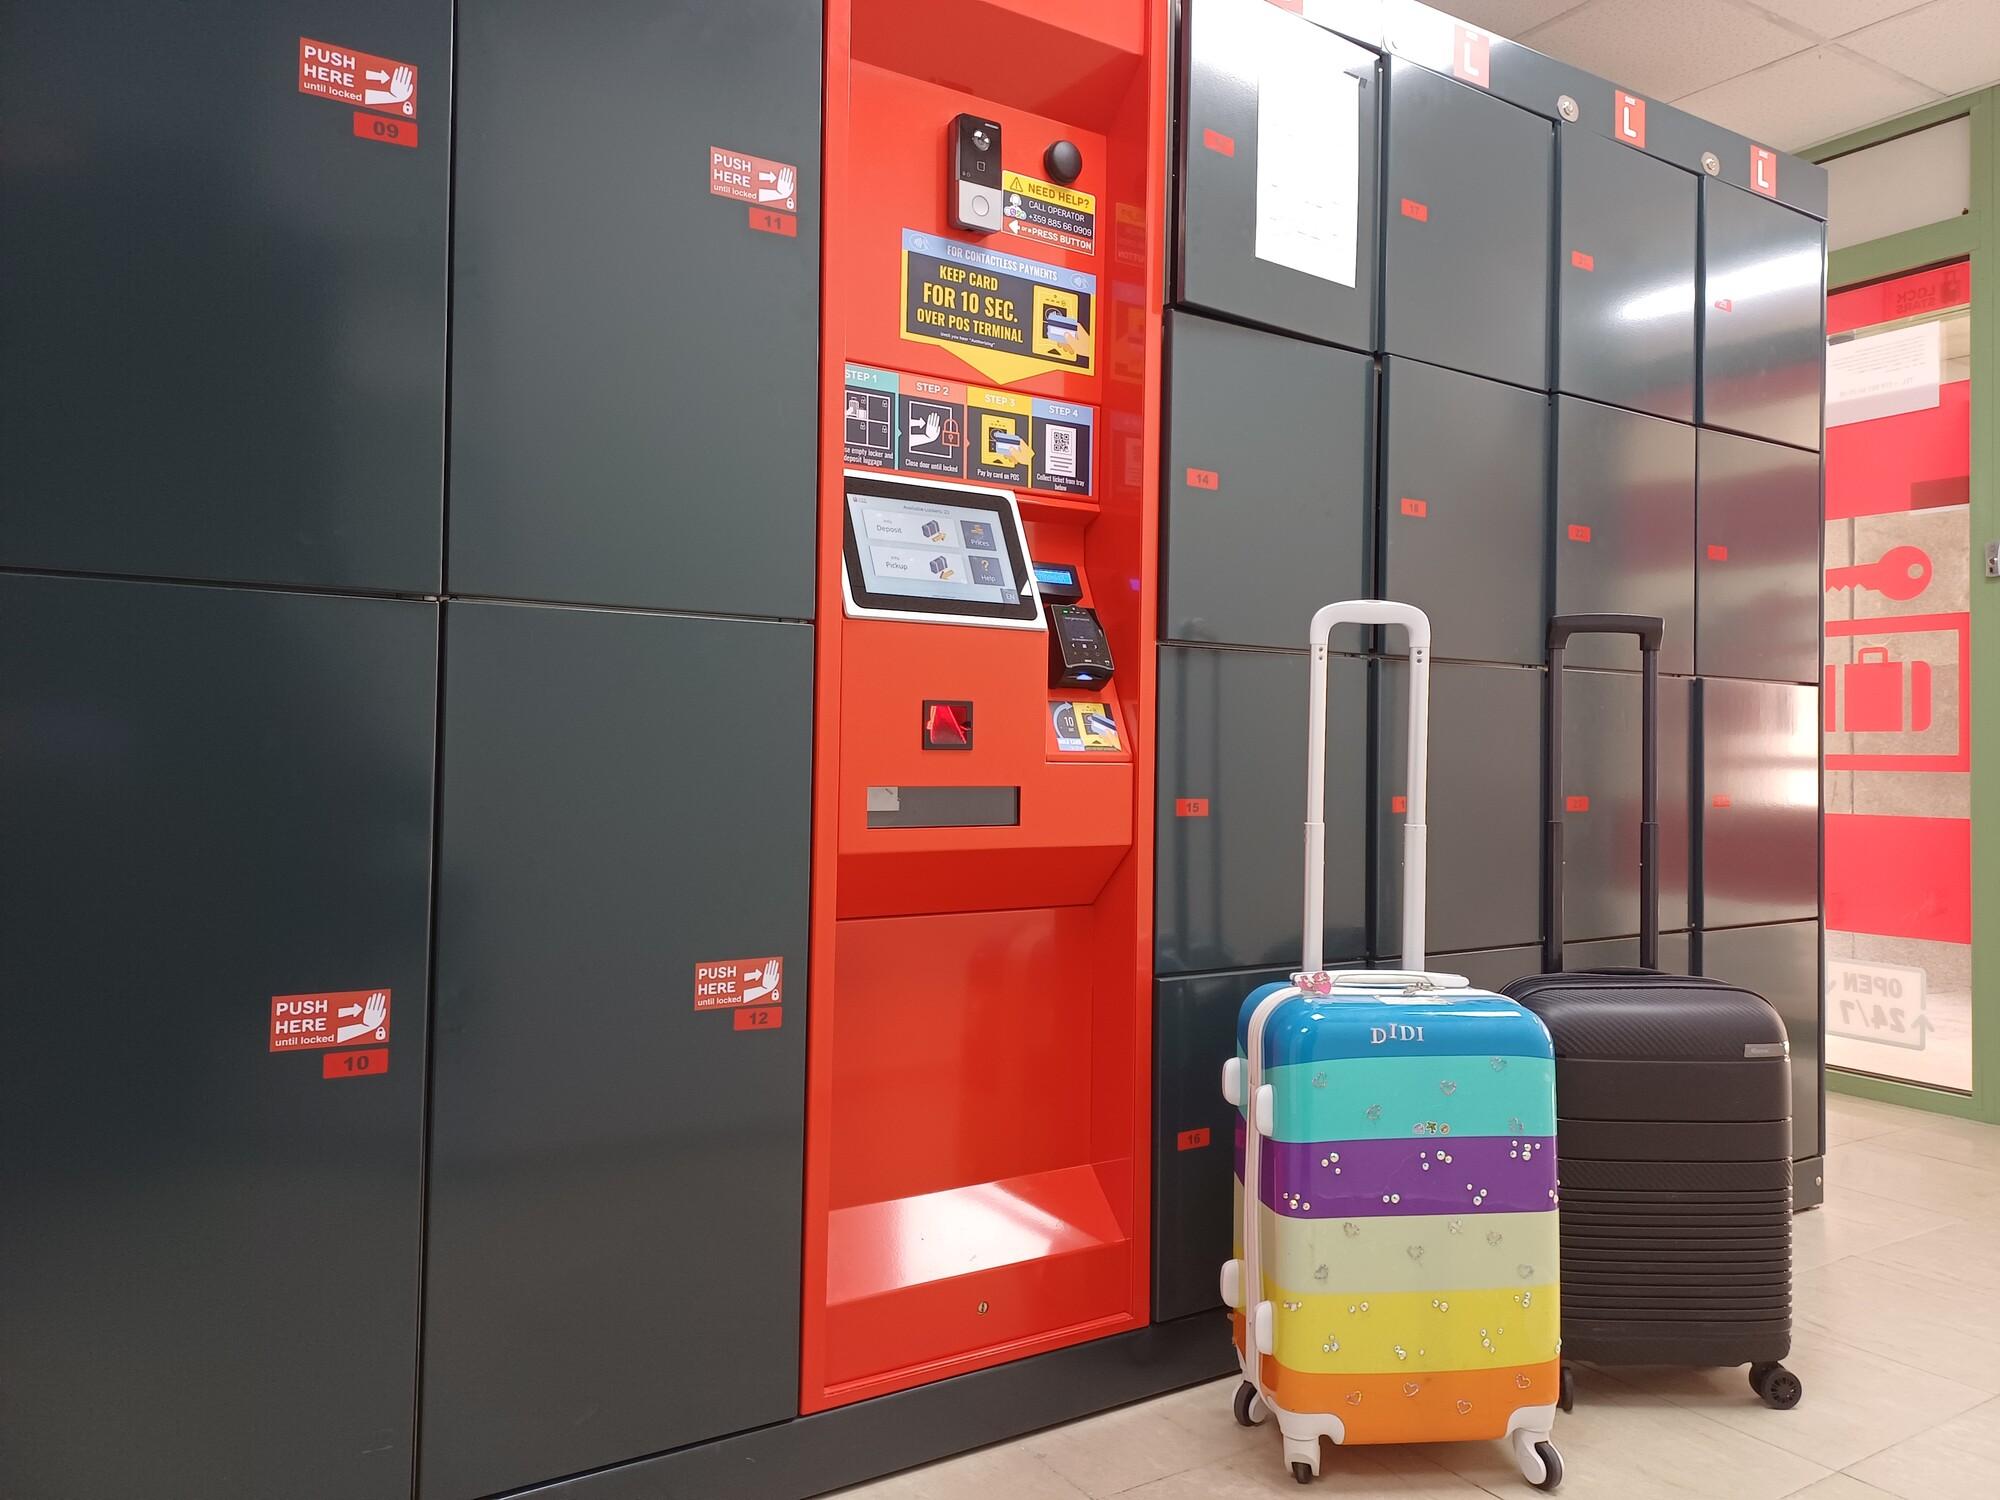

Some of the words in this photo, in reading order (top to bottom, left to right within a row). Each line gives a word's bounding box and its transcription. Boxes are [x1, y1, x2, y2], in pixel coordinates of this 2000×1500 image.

[304, 45, 356, 70] PUSH
[303, 63, 355, 88] HERE
[303, 81, 326, 93] until
[328, 86, 362, 102] locked
[372, 121, 399, 139] 09
[1623, 106, 1637, 138] L
[714, 153, 752, 173] PUSH
[713, 169, 751, 188] HERE
[1757, 159, 1769, 189] L
[713, 184, 731, 193] until
[732, 187, 757, 200] locked
[1028, 183, 1055, 199] NEED
[1058, 191, 1090, 209] HELP?
[1028, 200, 1047, 212] CALL
[1047, 206, 1085, 222] OPERATOR
[764, 215, 782, 230] 11
[1028, 213, 1047, 225] +359
[1047, 219, 1062, 230] 885
[1073, 225, 1092, 237] 0909
[1032, 228, 1059, 241] PRESS
[1059, 235, 1092, 251] BUTTON
[947, 245, 963, 259] FOR
[965, 250, 1017, 271] CONTACTLESS
[1019, 263, 1058, 281] PAYMENTS
[939, 264, 966, 284] KEEP
[969, 272, 998, 291] CARD
[923, 282, 956, 314] FOR
[961, 290, 979, 314] 10
[984, 296, 1018, 323] SEC.
[916, 308, 945, 327] OVER
[948, 315, 971, 332] POS
[973, 319, 1024, 344] TERMINAL
[845, 370, 870, 381] STEP
[872, 375, 878, 383] 1
[916, 382, 941, 393] STEP
[943, 386, 949, 395] 2
[984, 394, 1008, 404] STEP
[1009, 398, 1016, 407] 3
[1048, 405, 1071, 416] STEP
[1072, 409, 1079, 417] 4
[977, 468, 986, 477] Pay
[986, 470, 993, 478] by
[992, 471, 1004, 479] card
[1010, 472, 1020, 481] POS
[1036, 473, 1052, 482] Collect
[1197, 473, 1209, 485] 14
[876, 524, 903, 534] Deposit
[970, 538, 990, 547] Prices
[885, 561, 908, 570] Pickup
[1064, 716, 1074, 727] 10
[1187, 801, 1200, 814] 15
[698, 966, 737, 980] PUSH
[698, 981, 736, 996] HERE
[276, 1000, 328, 1016] PUSH
[697, 998, 715, 1006] until
[716, 995, 742, 1005] locked
[275, 1017, 327, 1034] HERE
[749, 1012, 768, 1025] 12
[275, 1036, 298, 1047] until
[300, 1034, 335, 1045] locked
[1370, 1024, 1425, 1044] DIDI
[344, 1055, 369, 1072] 10
[1188, 1133, 1201, 1145] 16
